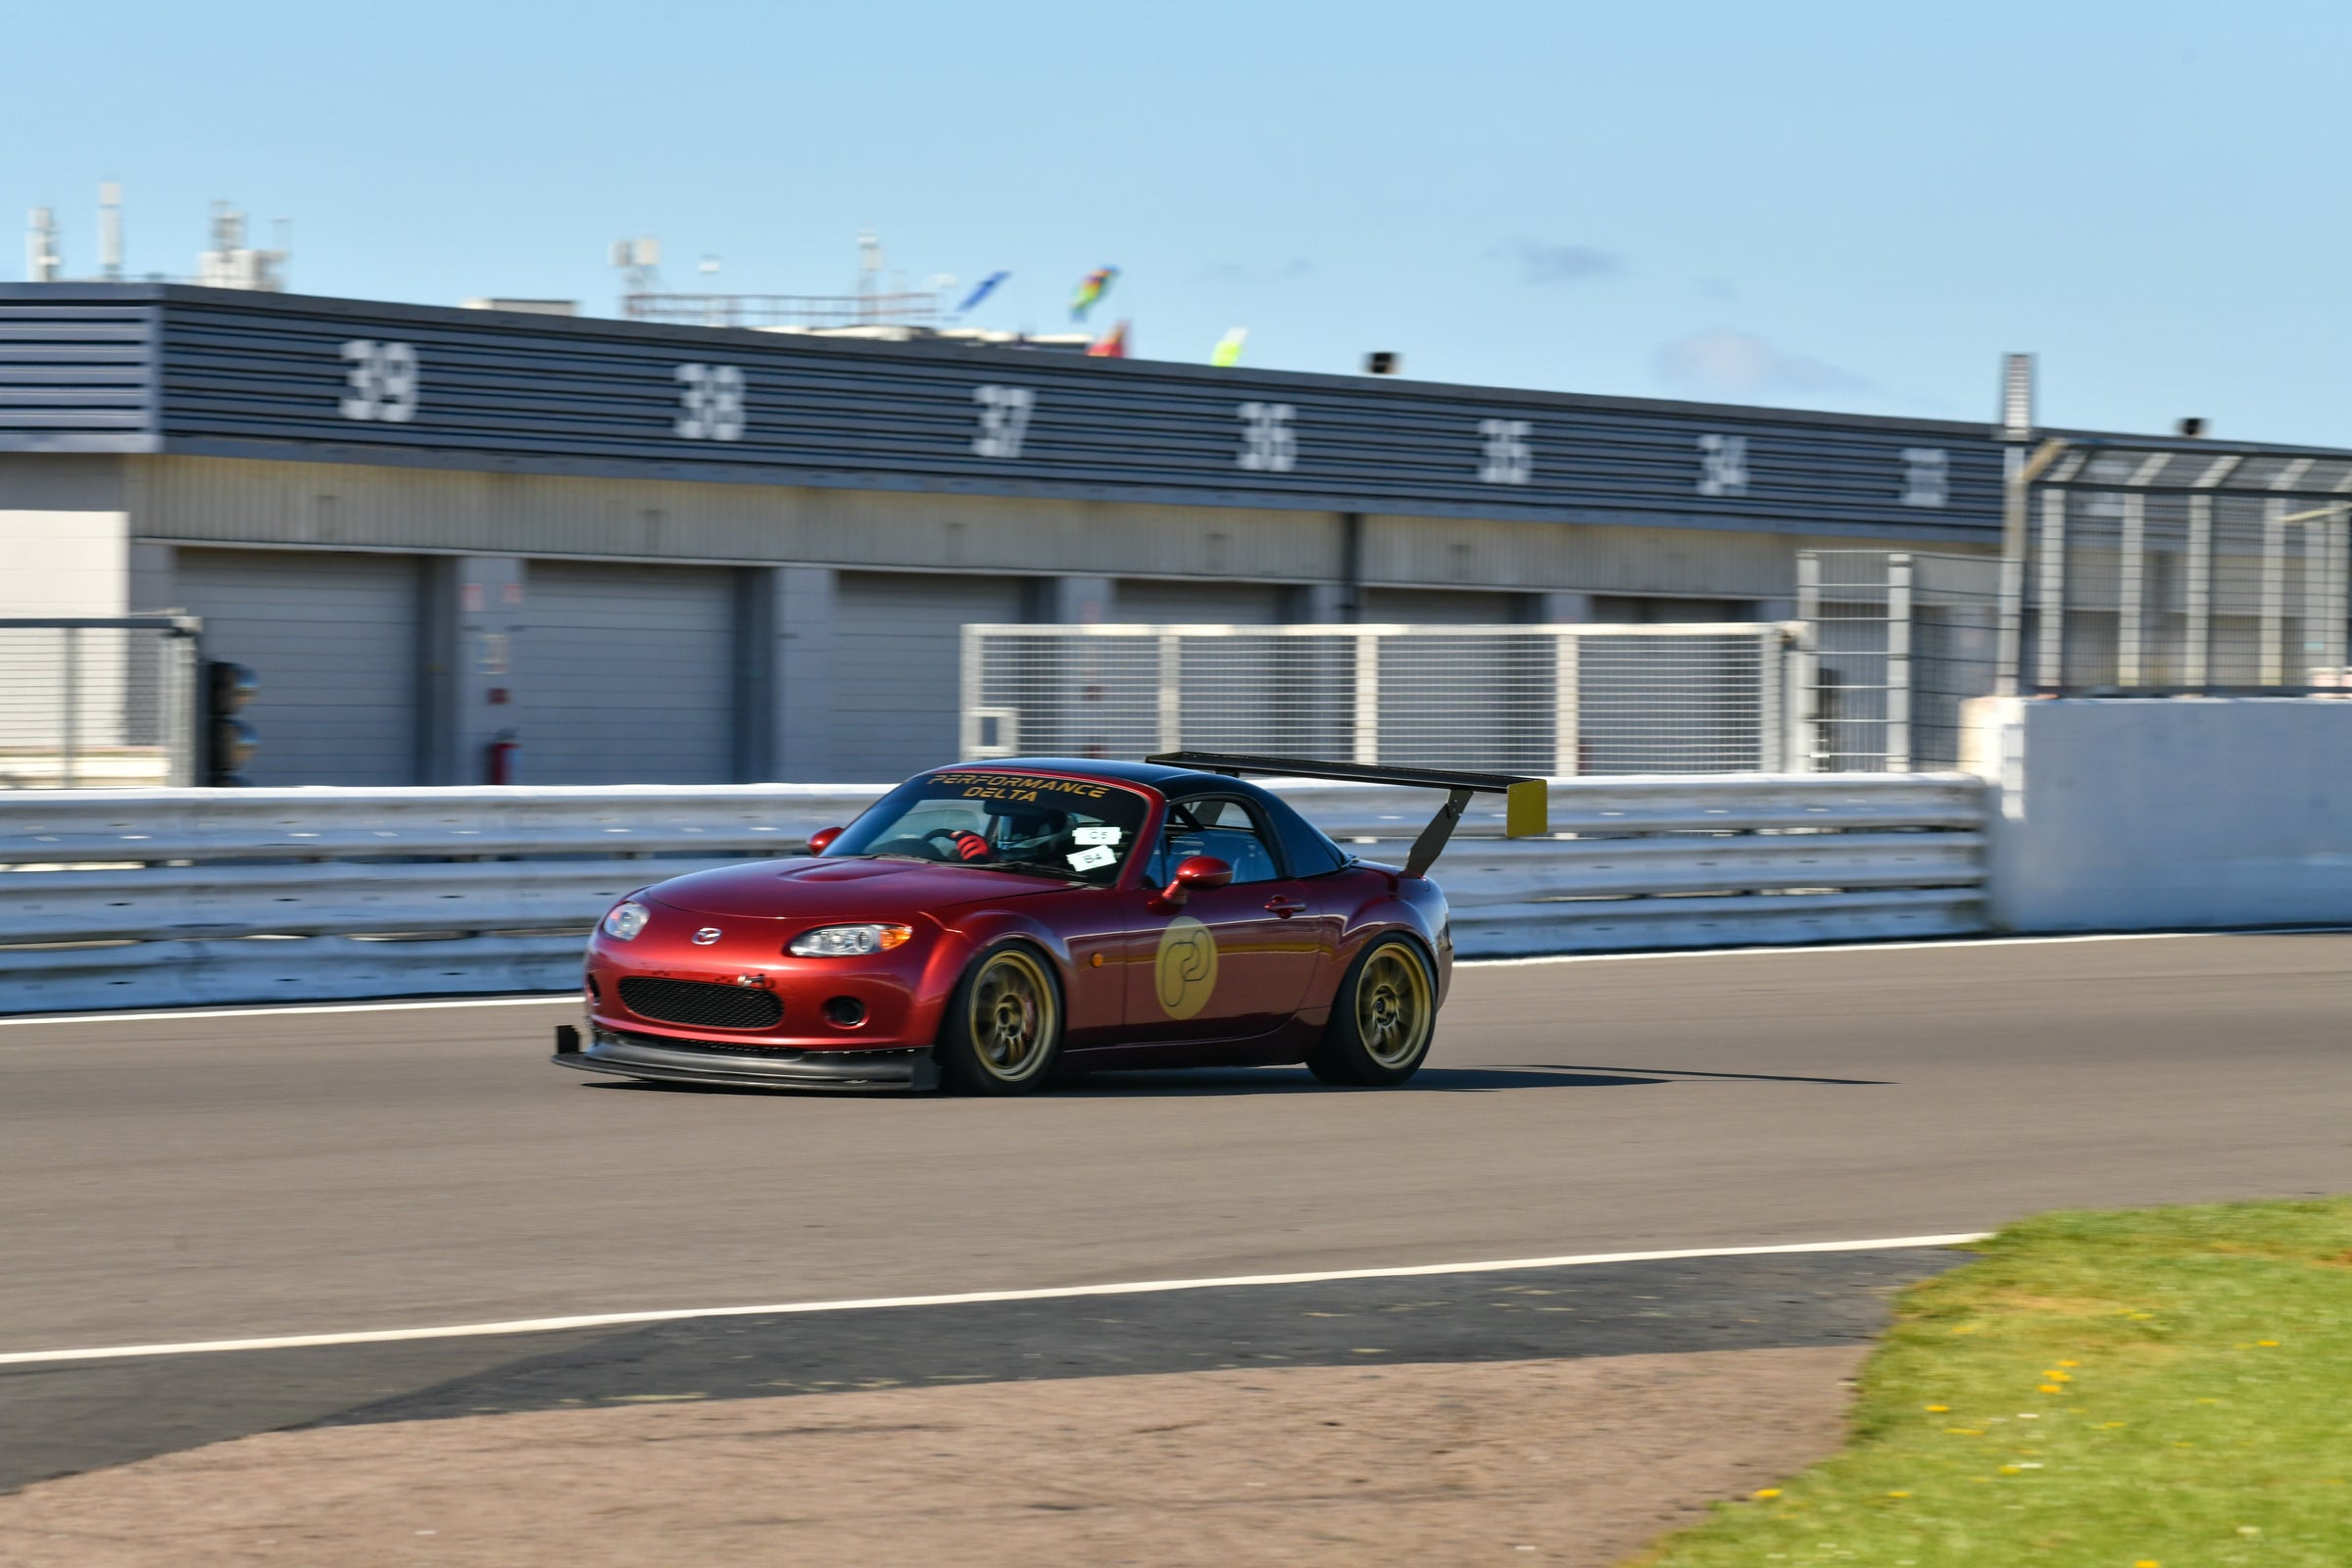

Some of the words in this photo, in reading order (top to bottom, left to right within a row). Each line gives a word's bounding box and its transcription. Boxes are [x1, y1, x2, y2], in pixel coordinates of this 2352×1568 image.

[339, 340, 419, 422] 39
[673, 363, 746, 441] 38
[972, 385, 1036, 458] 37
[928, 774, 1109, 799] PERFORMANCE
[962, 787, 1039, 803] DELTA
